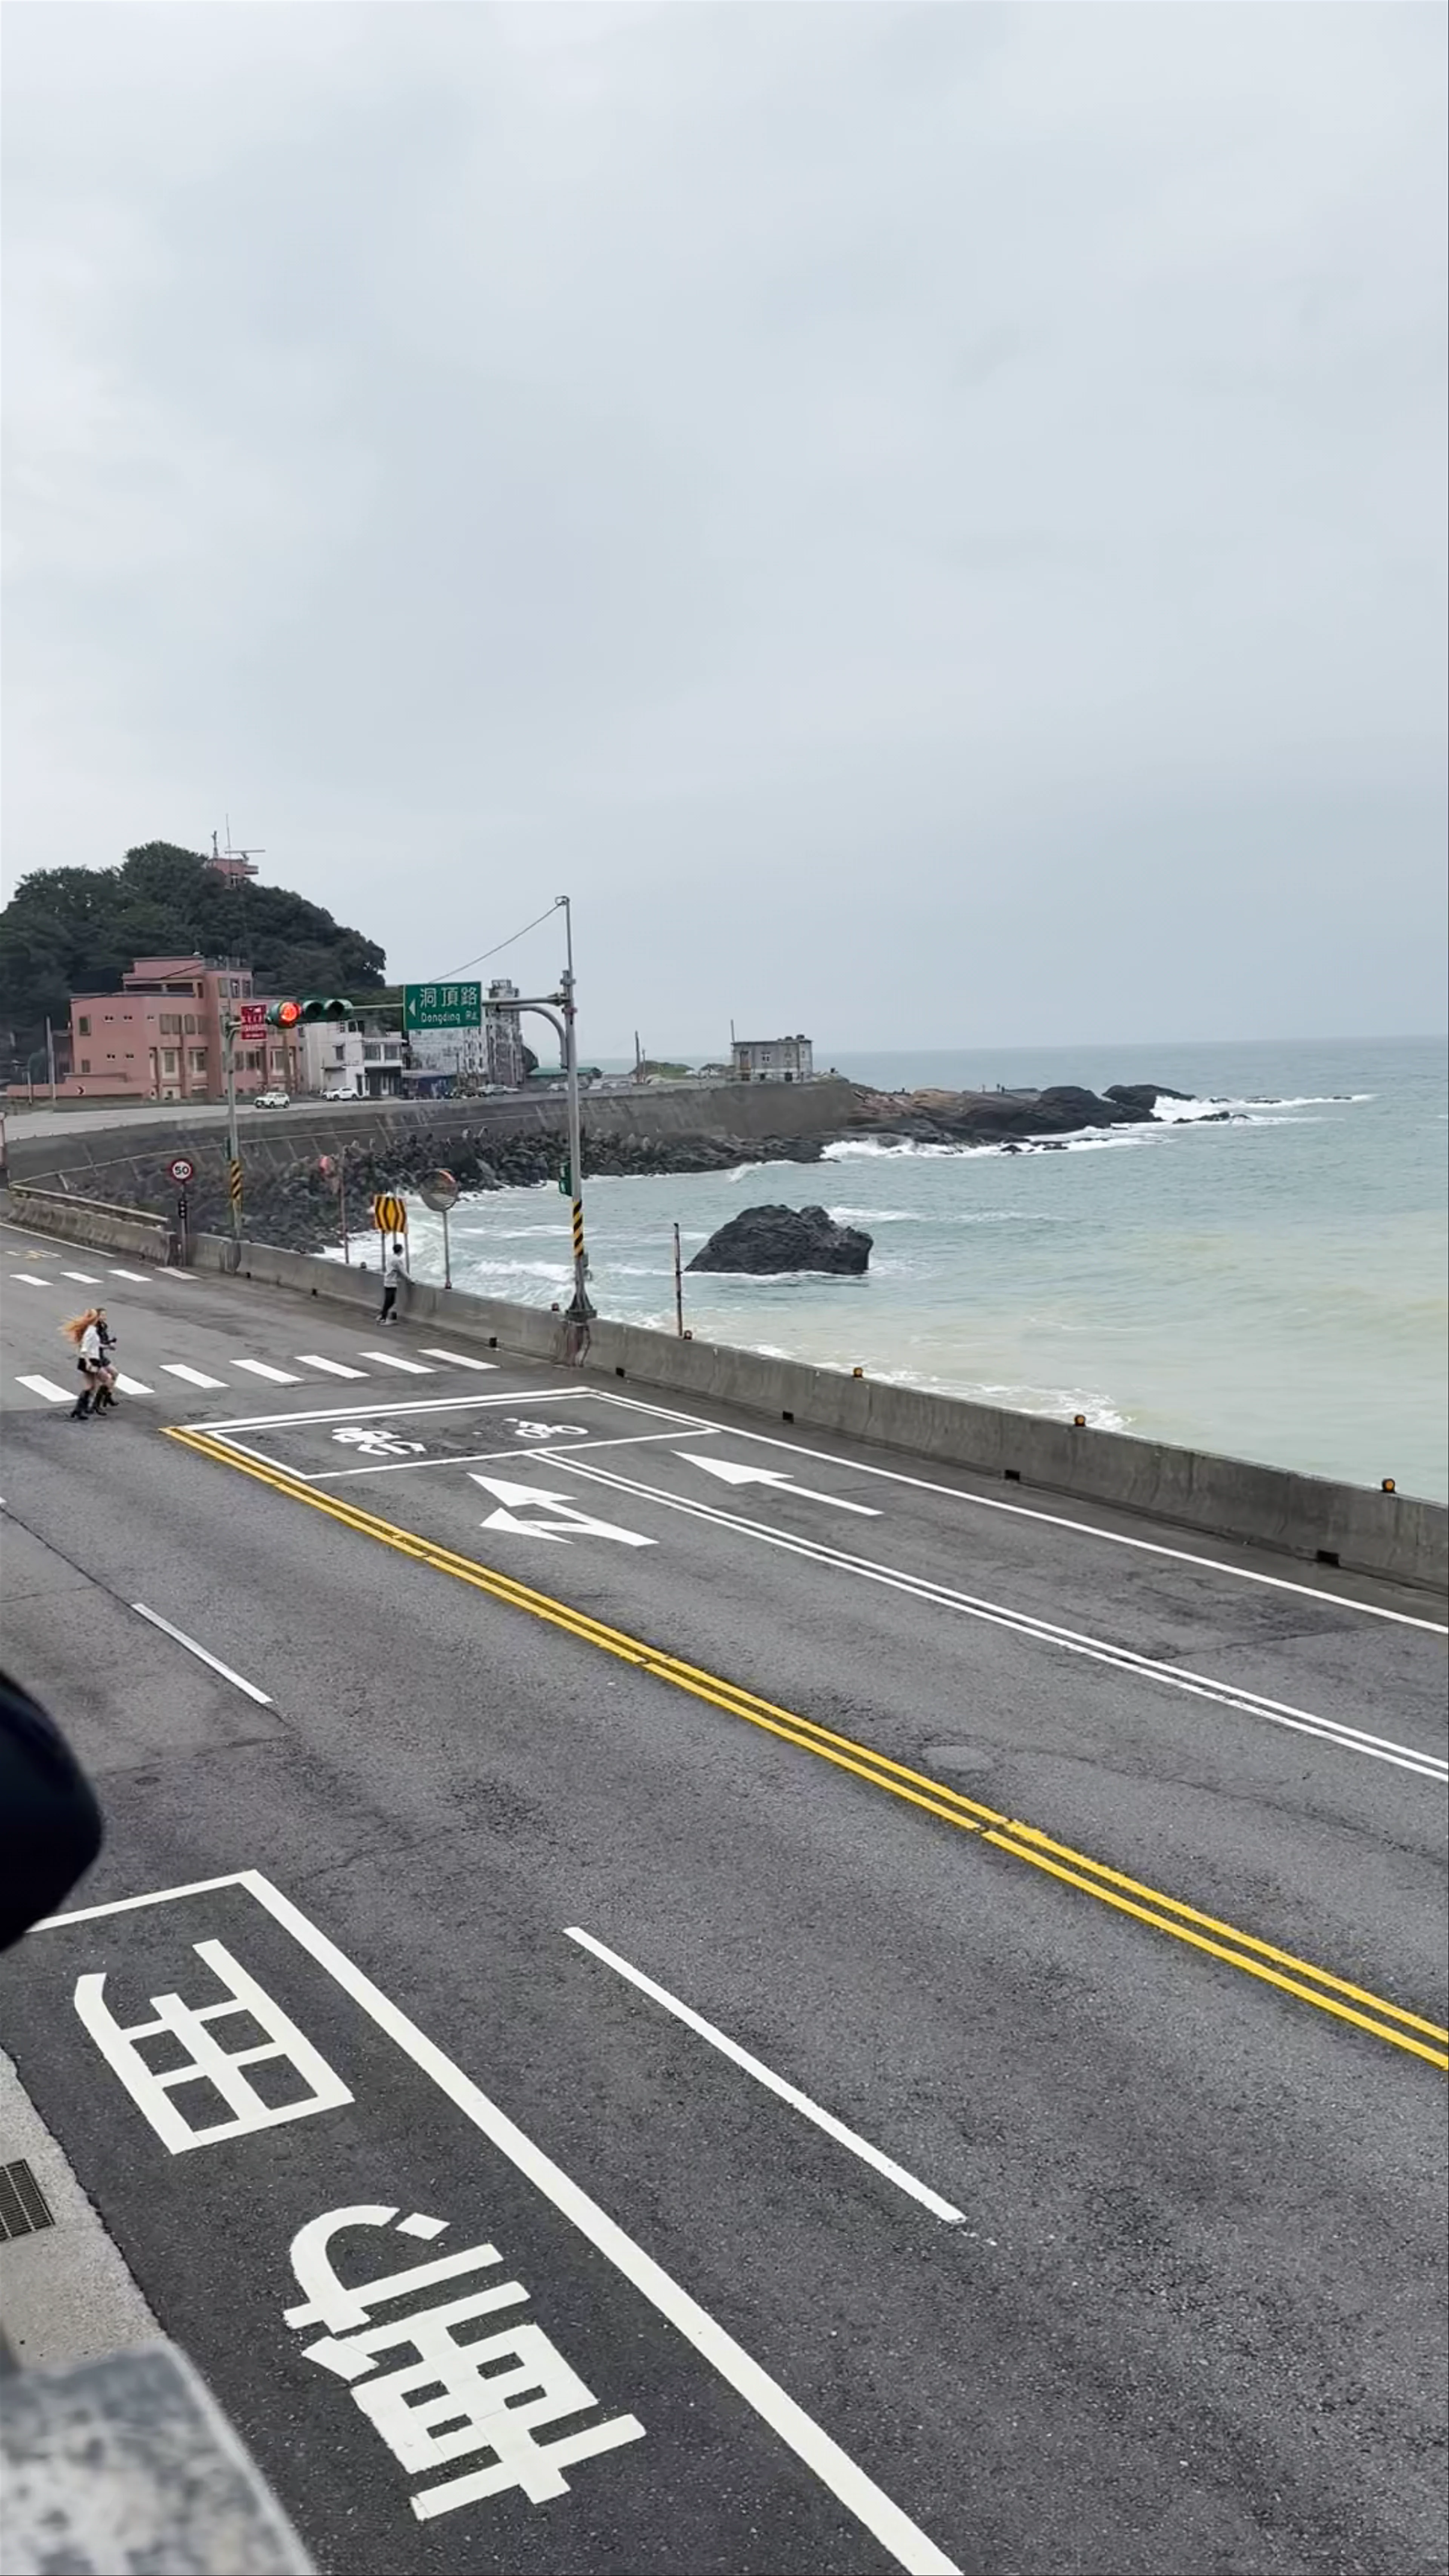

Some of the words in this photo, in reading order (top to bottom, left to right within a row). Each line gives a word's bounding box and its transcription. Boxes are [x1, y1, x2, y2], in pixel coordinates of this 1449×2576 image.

[420, 987, 477, 1008] 洞頂路
[421, 1012, 460, 1024] Dongding
[175, 1166, 189, 1175] 50
[74, 1939, 646, 2521] 專用
